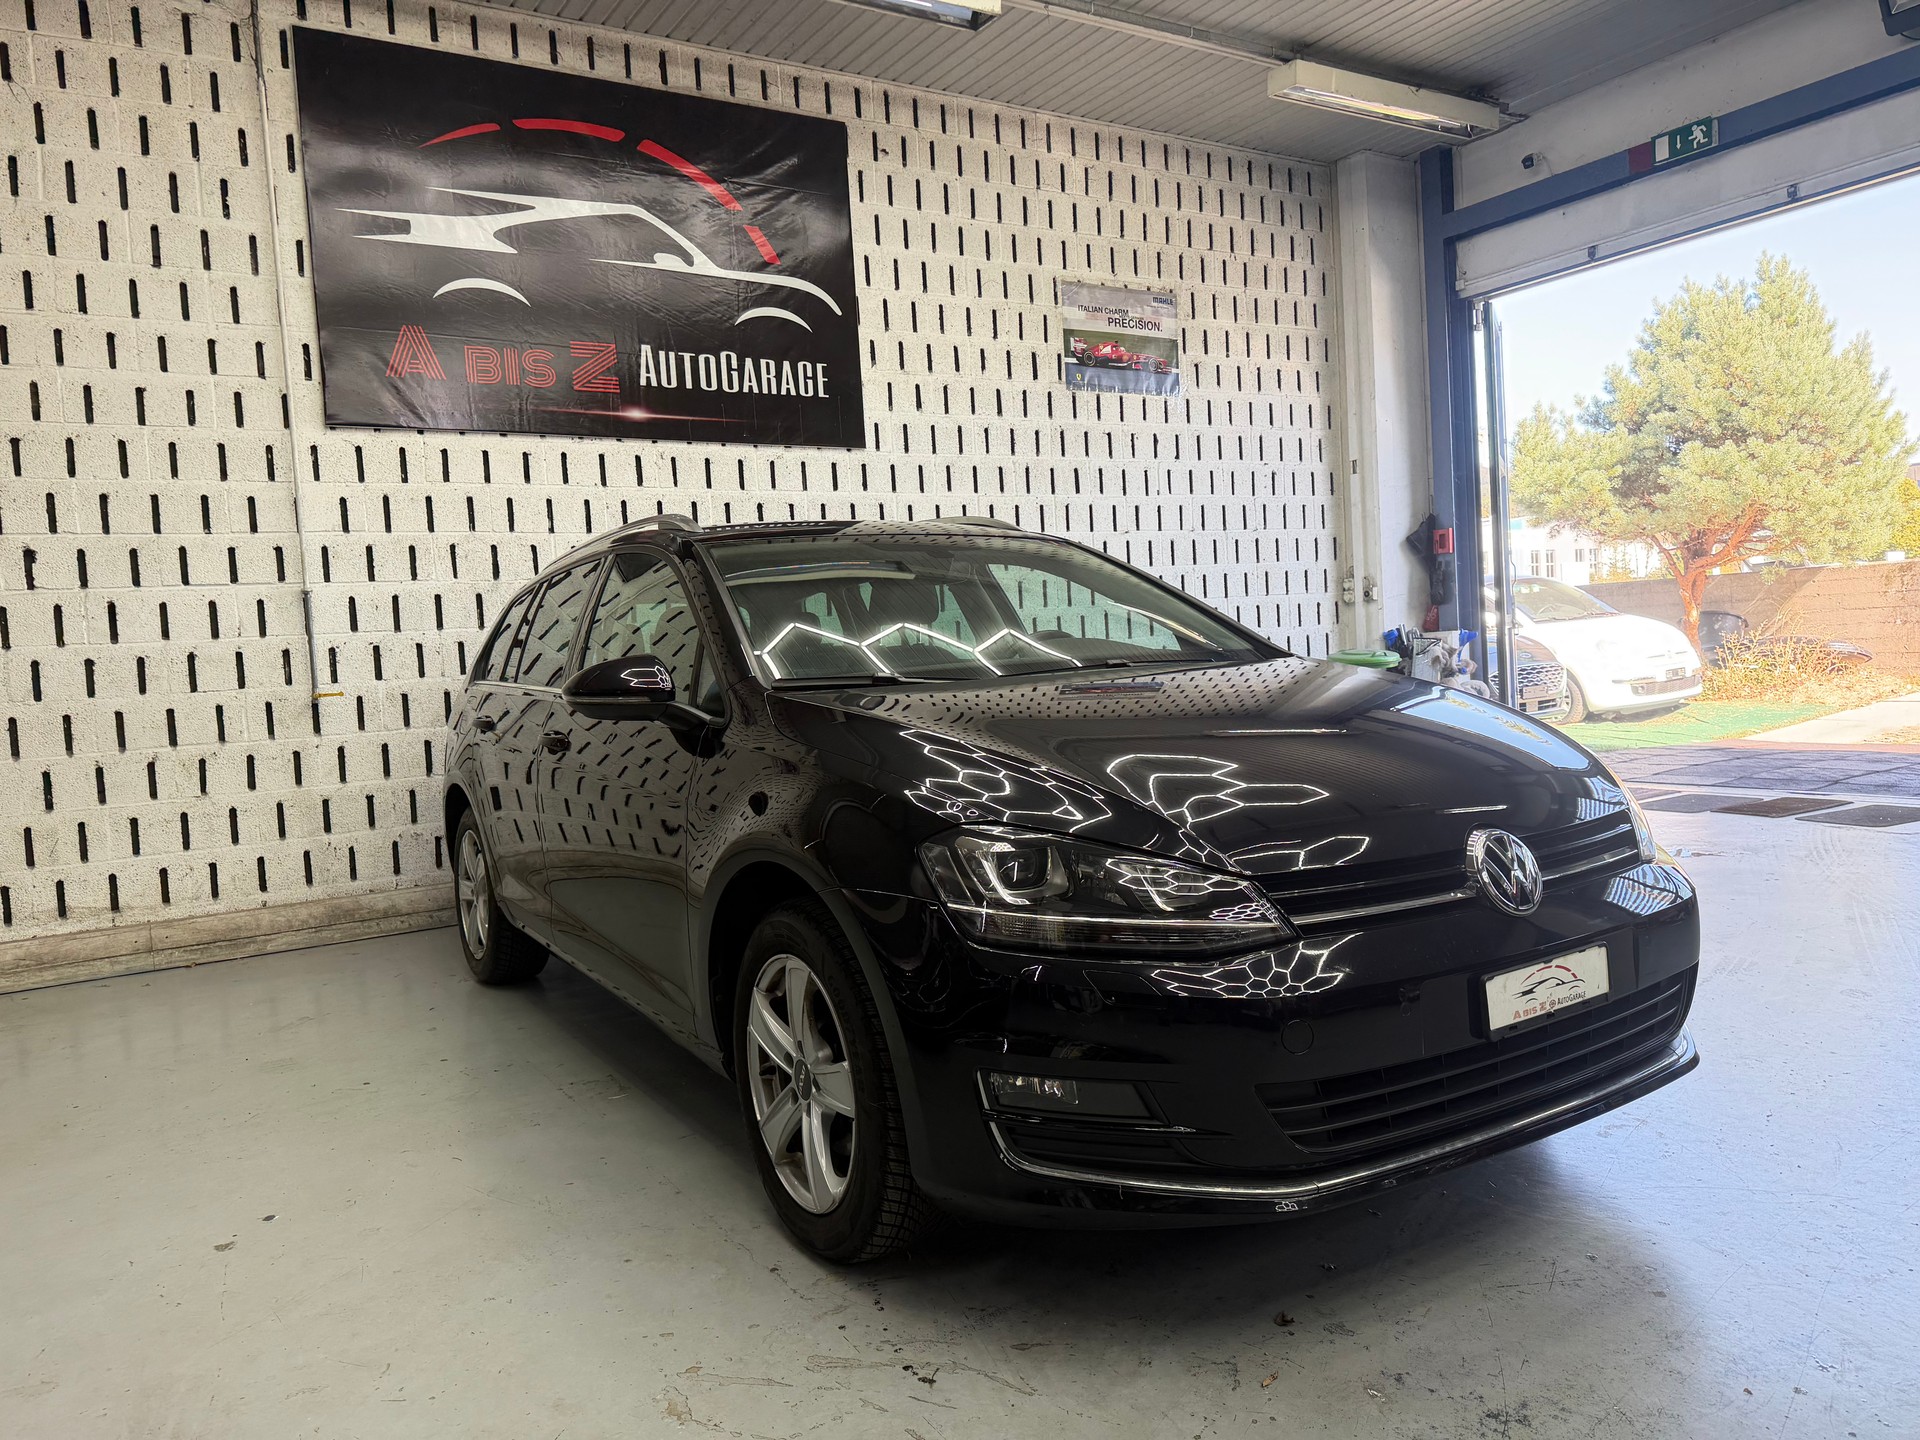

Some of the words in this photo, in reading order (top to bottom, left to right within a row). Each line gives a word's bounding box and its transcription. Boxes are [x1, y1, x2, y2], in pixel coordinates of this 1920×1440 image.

[1152, 296, 1174, 306] MAHLE
[1077, 304, 1103, 314] ITALIAN
[1104, 307, 1129, 316] CHARM
[1107, 317, 1163, 332] PRECISION.
[385, 324, 447, 380] A
[464, 345, 556, 388] BIS
[569, 340, 621, 393] Z
